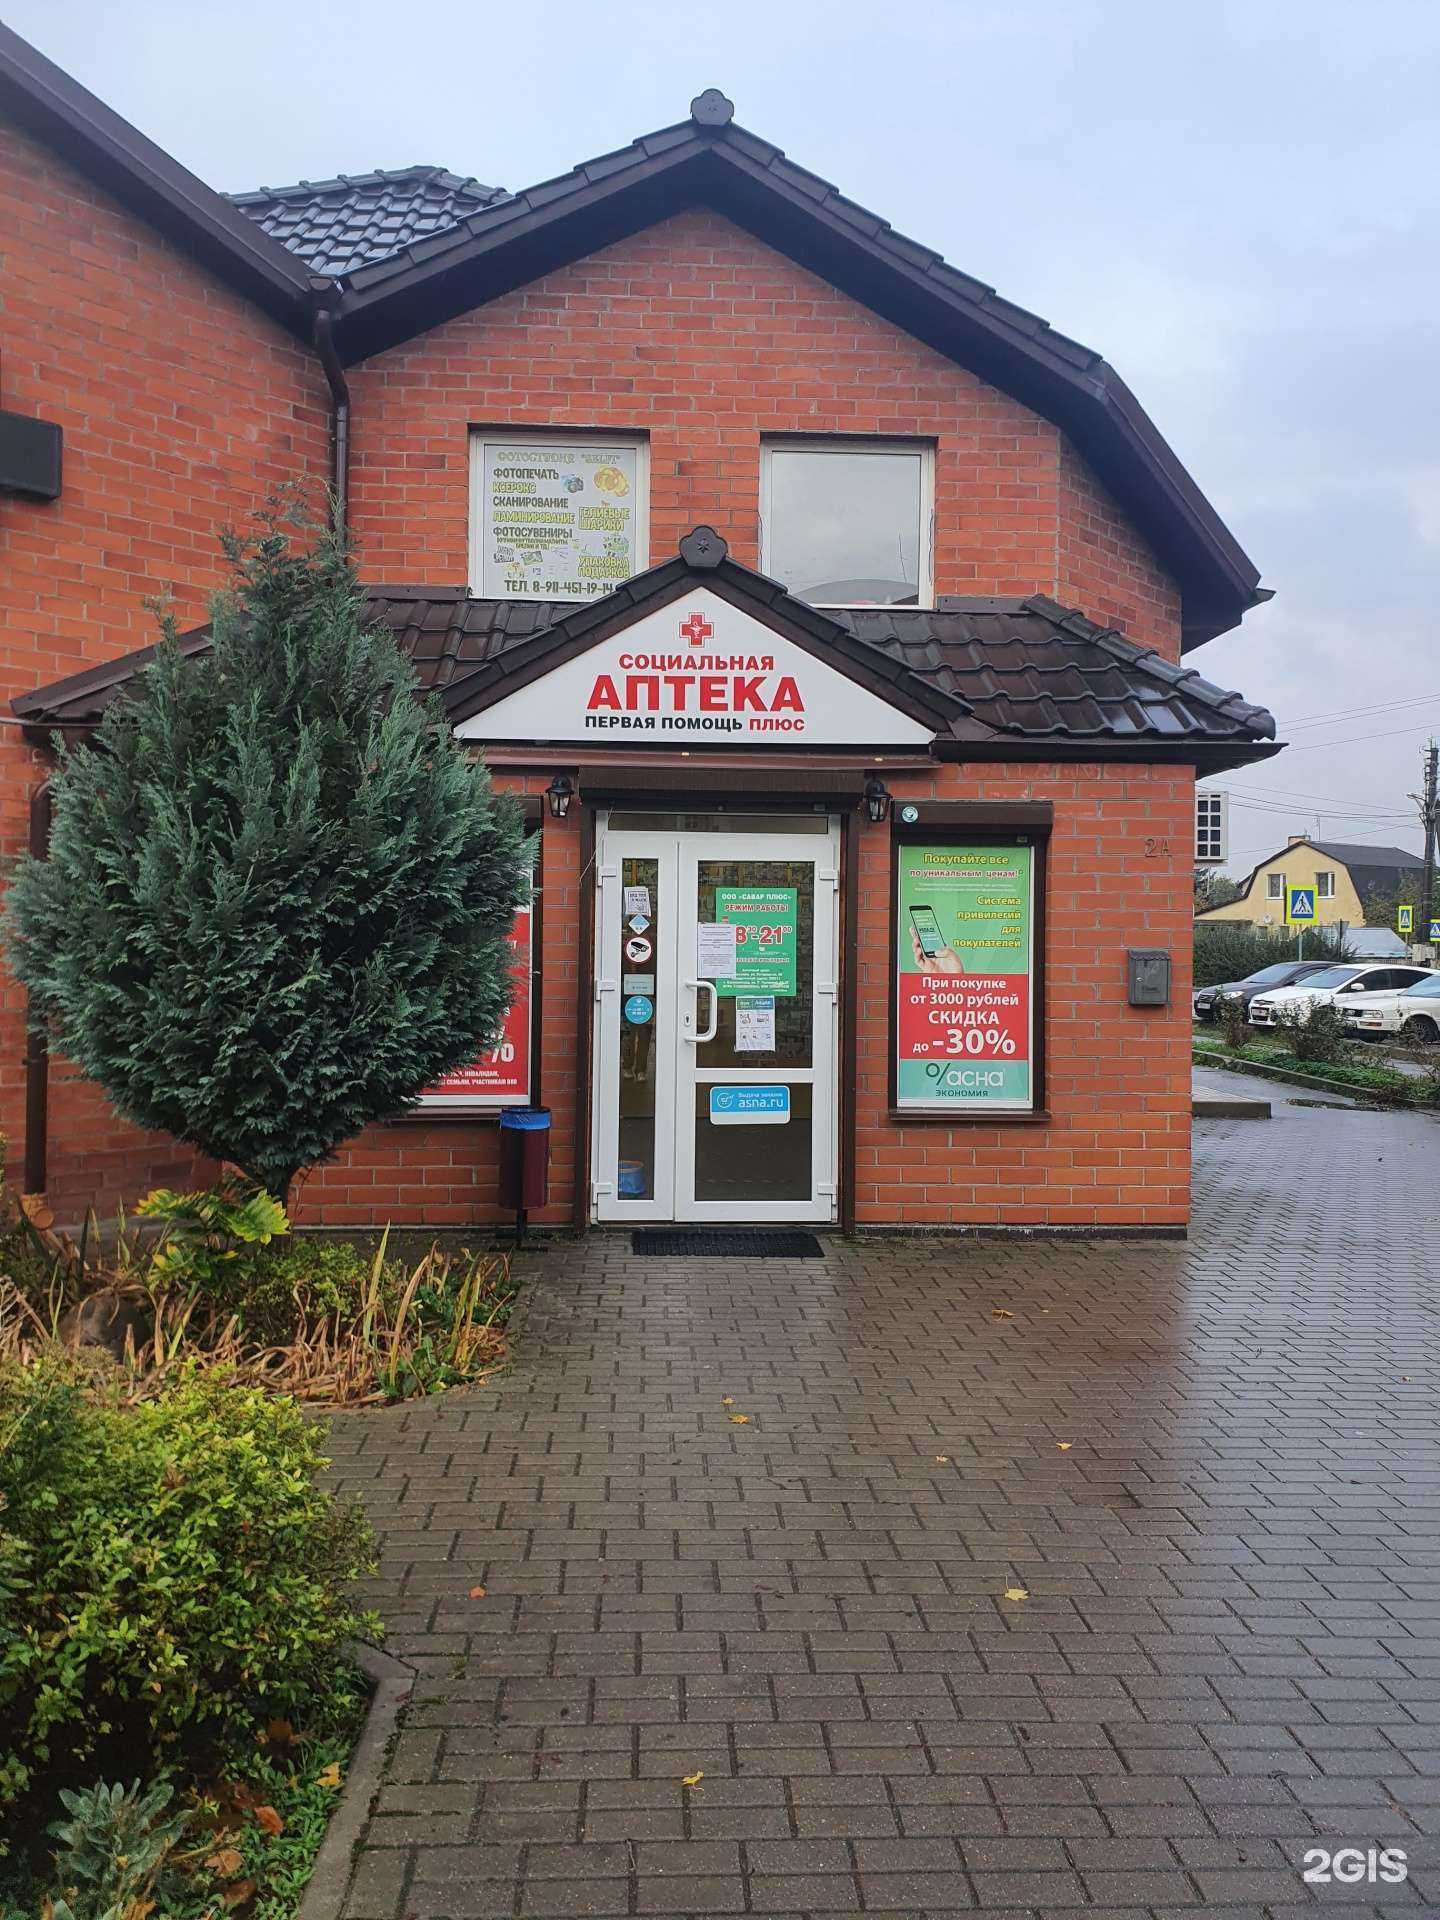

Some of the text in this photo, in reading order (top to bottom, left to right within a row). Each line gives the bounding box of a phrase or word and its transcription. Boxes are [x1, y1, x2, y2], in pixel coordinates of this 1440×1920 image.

[493, 468, 559, 480] ФОТОПЕЧАТЬ
[493, 482, 536, 493] КСЕРОКС
[493, 497, 569, 508] СКАНИРОВАНИЕ
[493, 511, 575, 524] ЛАМИНИРОВАНИЕ
[578, 507, 630, 519] ГЕЛИЕВЫЕ
[578, 519, 624, 530] ШАРИКИ
[493, 527, 573, 539] ФОТОСУВЕНИРЫ
[579, 556, 629, 568] УПАКОВКА
[578, 567, 630, 579] ПОДАРКОВ
[504, 580, 613, 594] ТЕЛ. 8-911-451-19-14
[619, 654, 774, 671] СОЦИАЛЬНАЯ
[586, 675, 805, 712] АПТЕКА
[585, 716, 805, 732] ПЕРВАЯ ПОМОЩЬ ПЛЮС
[923, 853, 1009, 865] Покупайте все
[923, 870, 982, 879] уникальным
[977, 896, 1021, 905] Система
[725, 904, 789, 912] РЕЖИМ РАБОТЫ
[957, 910, 1021, 921] привилегий
[1001, 926, 1021, 934] для
[953, 938, 1021, 949] покупателей
[922, 977, 1006, 991] При покупке
[910, 993, 1019, 1007] от 3000 рублей
[928, 1010, 1000, 1027] СКИДКА
[912, 1042, 929, 1053] до
[738, 1099, 784, 1108] asna.ru
